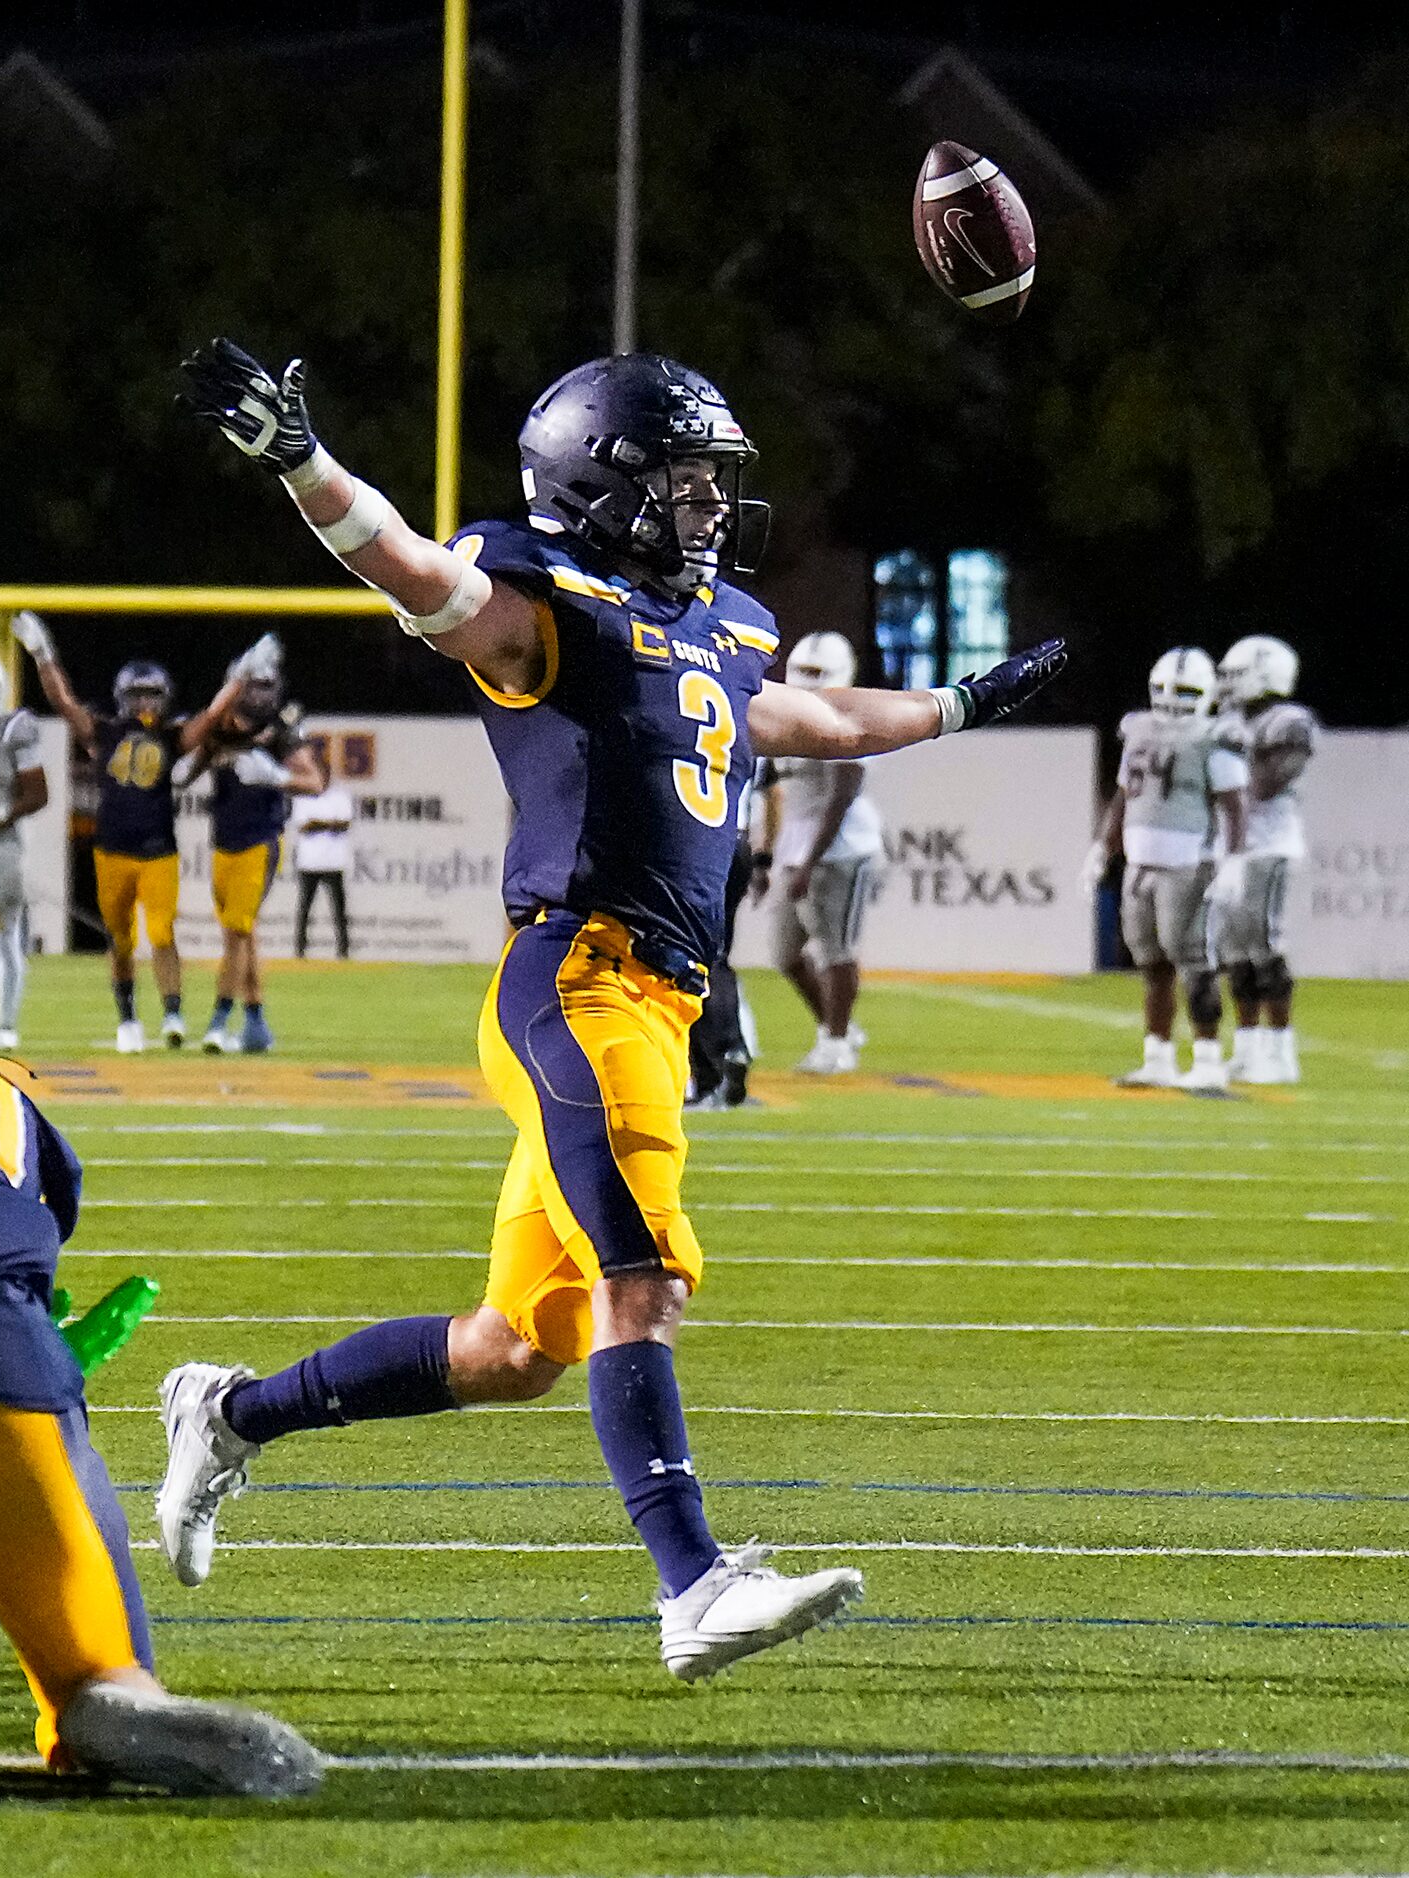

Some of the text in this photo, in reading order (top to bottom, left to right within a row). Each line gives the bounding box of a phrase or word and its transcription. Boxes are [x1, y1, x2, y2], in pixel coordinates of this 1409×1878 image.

[631, 620, 669, 659] C
[672, 669, 736, 828] 3
[352, 795, 442, 822] NTING
[352, 847, 494, 896] Knight
[910, 867, 1056, 906] TEXAS
